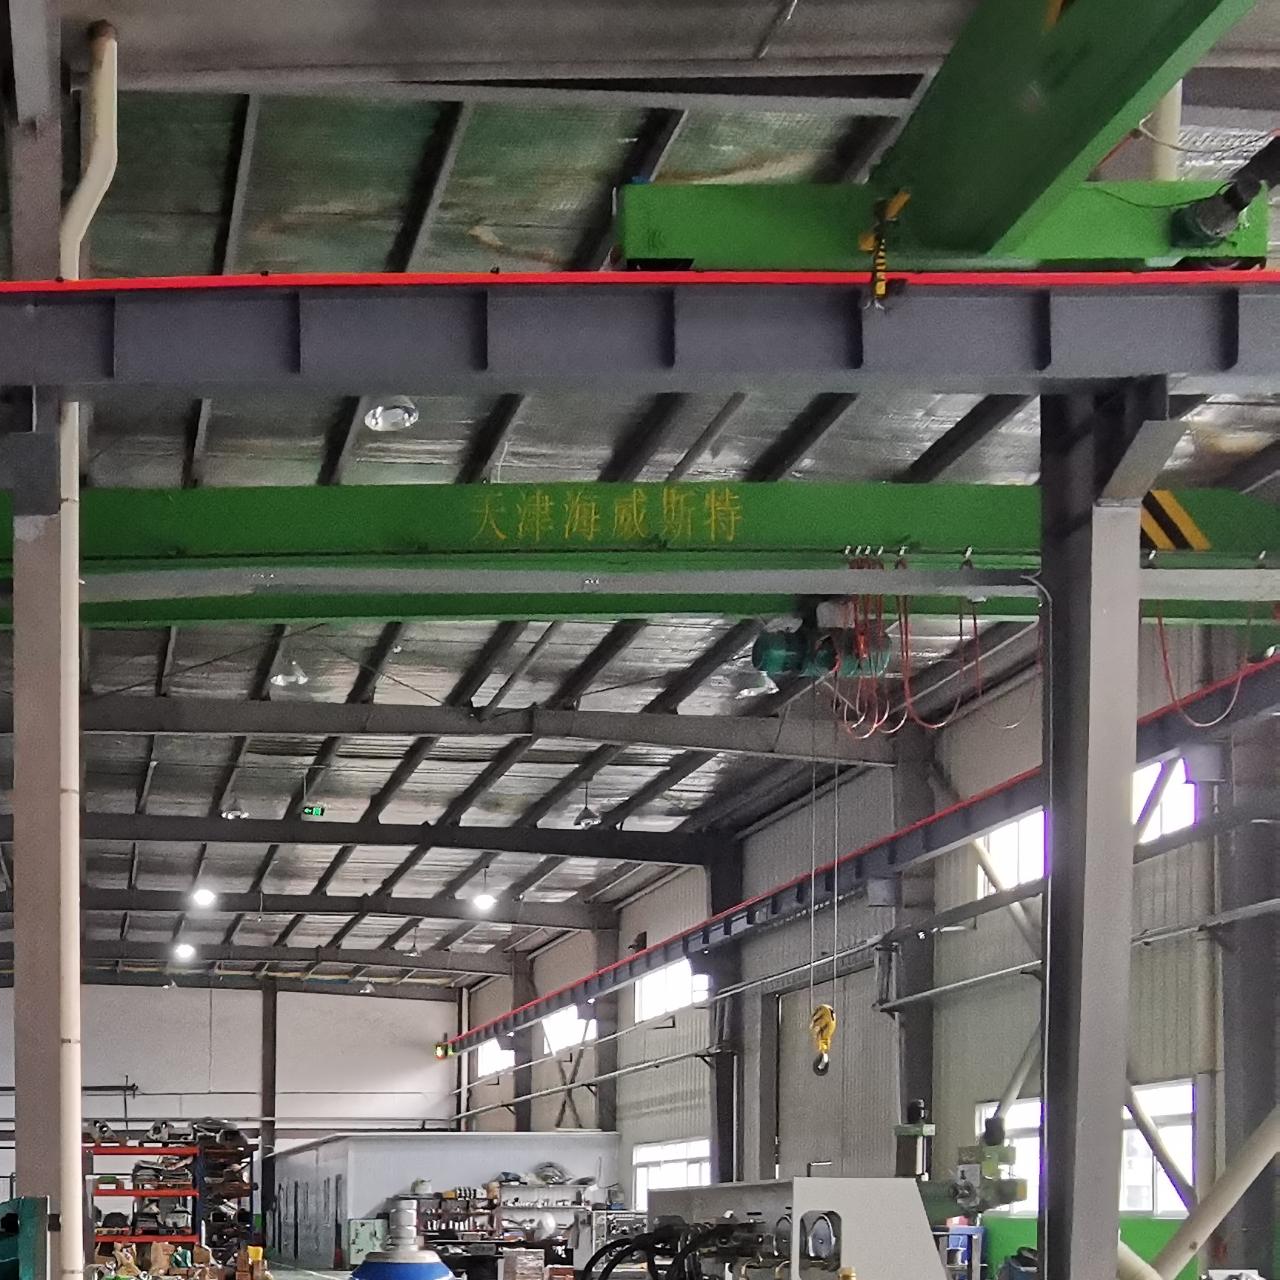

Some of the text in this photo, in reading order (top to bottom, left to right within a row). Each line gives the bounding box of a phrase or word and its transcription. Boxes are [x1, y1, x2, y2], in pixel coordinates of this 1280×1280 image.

[471, 487, 742, 542] 天津海威斯特
